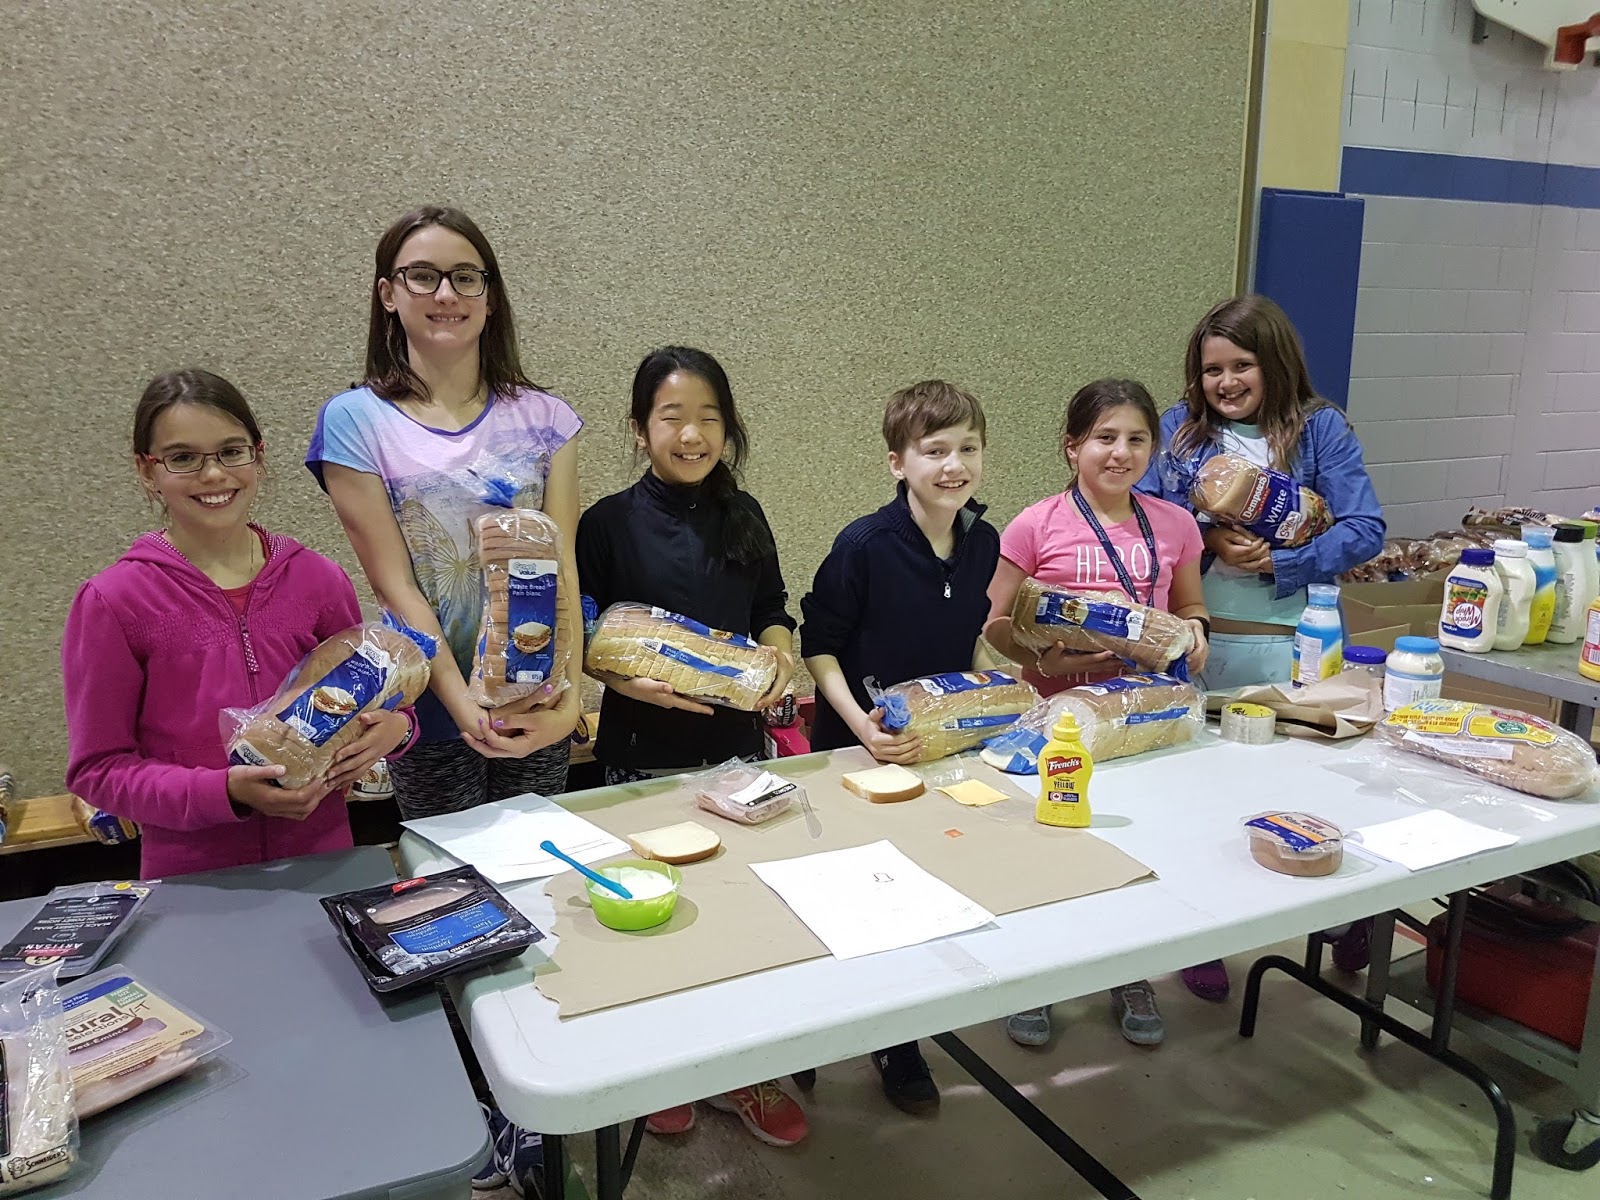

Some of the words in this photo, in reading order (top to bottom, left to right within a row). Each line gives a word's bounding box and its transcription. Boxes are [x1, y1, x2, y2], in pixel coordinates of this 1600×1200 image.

[1242, 475, 1268, 520] Dempster's
[1264, 488, 1288, 525] White
[1455, 609, 1481, 626] Miracle
[1456, 606, 1473, 617] Whip
[1049, 758, 1080, 771] French's
[1054, 781, 1075, 790] YELLOW
[472, 920, 493, 929] Ham
[25, 942, 84, 950] ARTISAN
[449, 936, 486, 953] KIRKLAND
[65, 1006, 125, 1038] tural
[67, 1013, 129, 1043] selections
[69, 1026, 130, 1054] ved-Émincé
